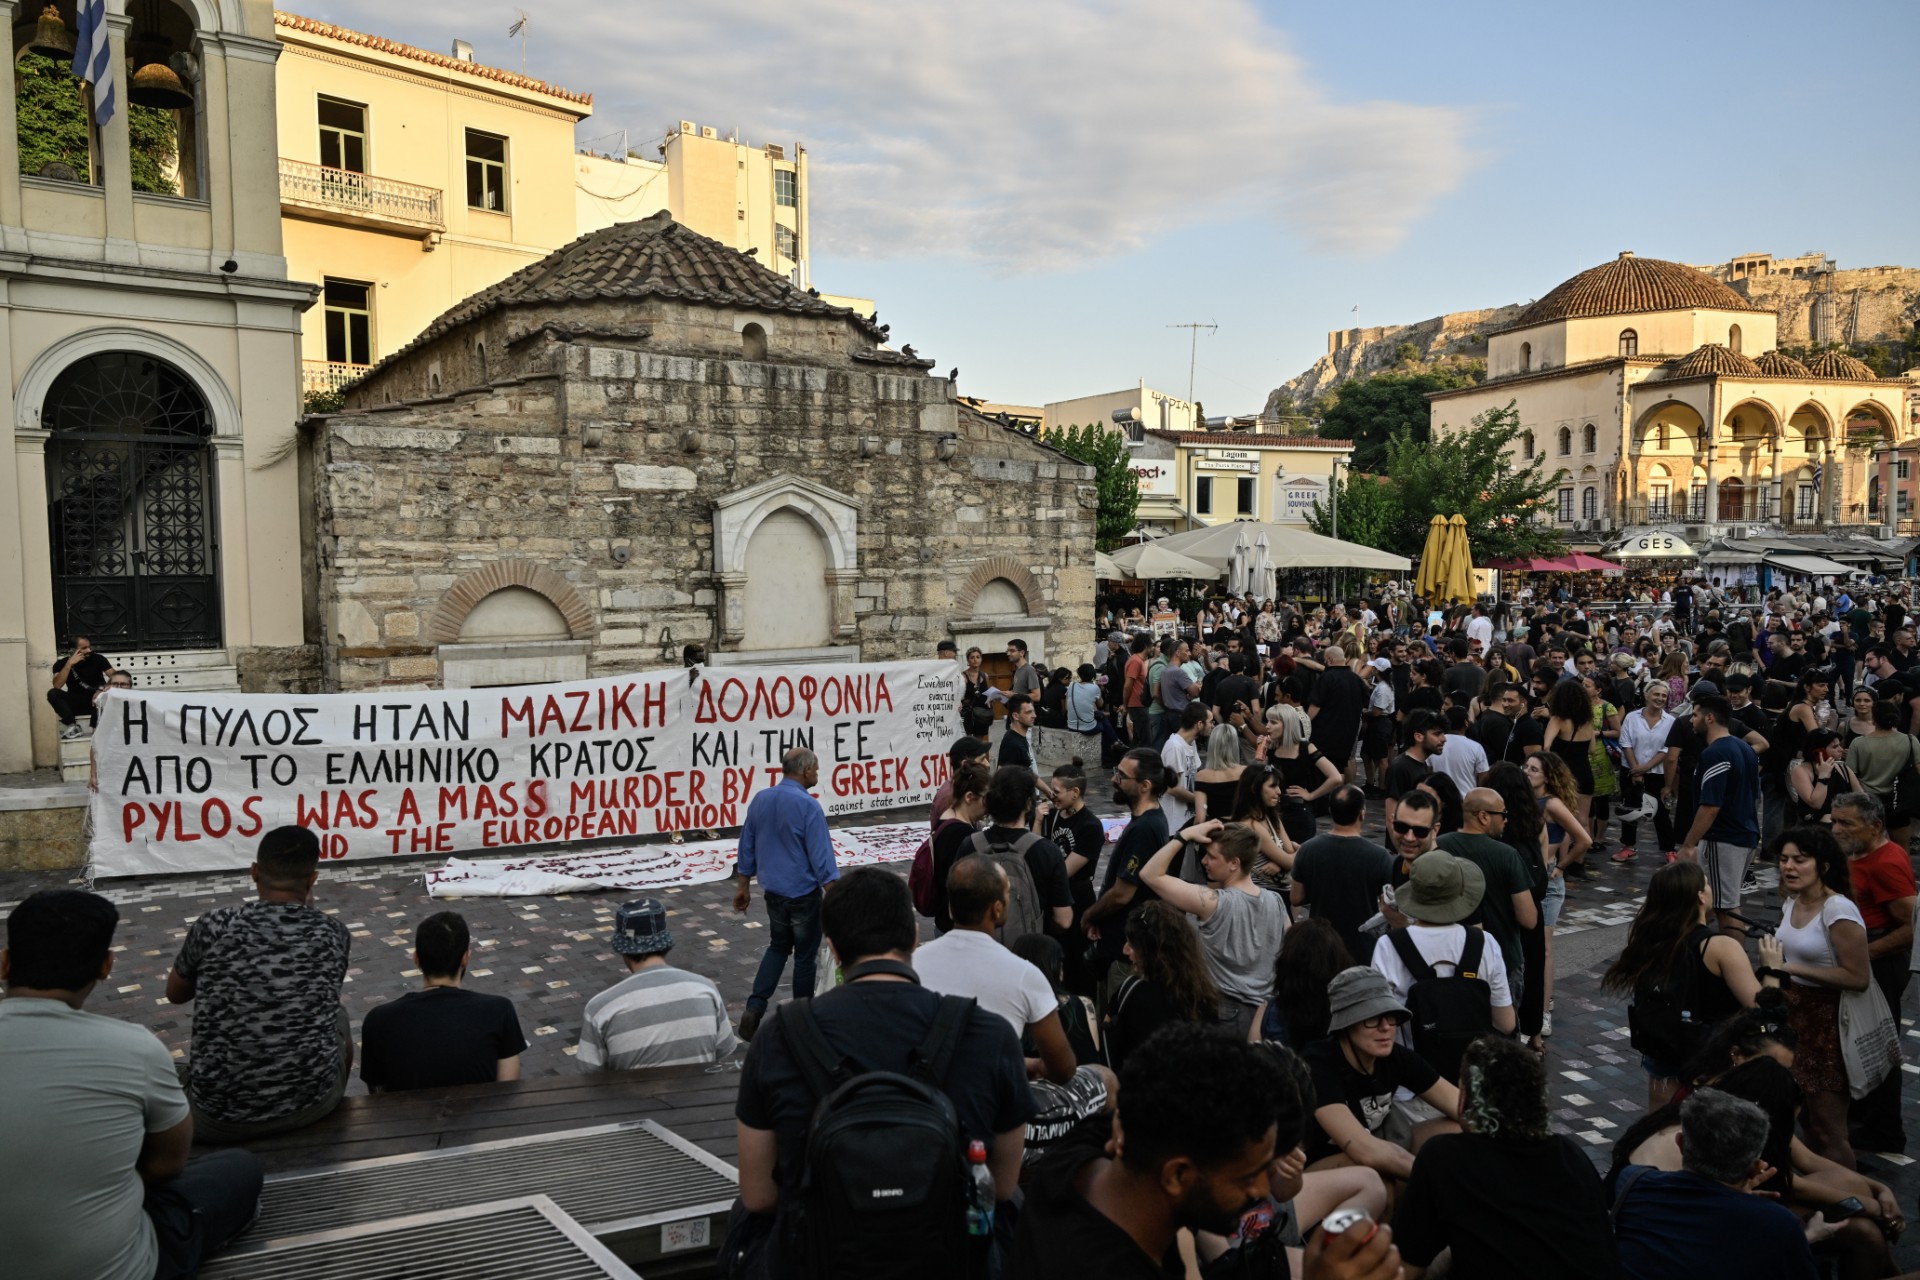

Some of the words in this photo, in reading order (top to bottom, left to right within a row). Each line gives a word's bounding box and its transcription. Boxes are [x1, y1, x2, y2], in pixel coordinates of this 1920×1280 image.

[1151, 391, 1190, 412] ΨΡΙΑ
[1221, 450, 1248, 459] Lagom
[1288, 491, 1318, 499] GREEK
[1639, 538, 1673, 549] GES
[123, 700, 148, 745] Η
[180, 704, 323, 747] ΠΥΛΟΣ
[353, 700, 470, 742] ΗΤΑΝ
[501, 681, 667, 739] ΜΑΖΙΚΗ
[694, 672, 893, 724] ΔΟΛΟΦΟΝΙΑ
[121, 755, 213, 796] ΑΠΟ
[240, 753, 298, 789] ΤΟ
[326, 747, 500, 785] ΕΛΛΗΝΙΚΟ
[530, 735, 658, 780] ΚΡΑΤΟΣ
[692, 730, 739, 767] ΚΑΙ
[759, 726, 814, 764] ΤΗΝ
[834, 720, 875, 762] ΕΕ
[122, 795, 264, 843] PYLOS
[296, 788, 380, 831] WAS
[397, 787, 422, 827] A
[438, 779, 547, 822] MASS
[569, 769, 706, 815] MURDER
[722, 765, 756, 805] BY
[831, 755, 910, 797] GREEK
[919, 751, 953, 789] STAT
[828, 799, 864, 815] against
[870, 796, 894, 808] state
[898, 792, 921, 804] crime
[924, 792, 933, 802] in
[318, 833, 349, 860] ND
[385, 821, 456, 855] THE
[482, 807, 637, 847] EUROPEAN
[655, 803, 737, 832] UNION
